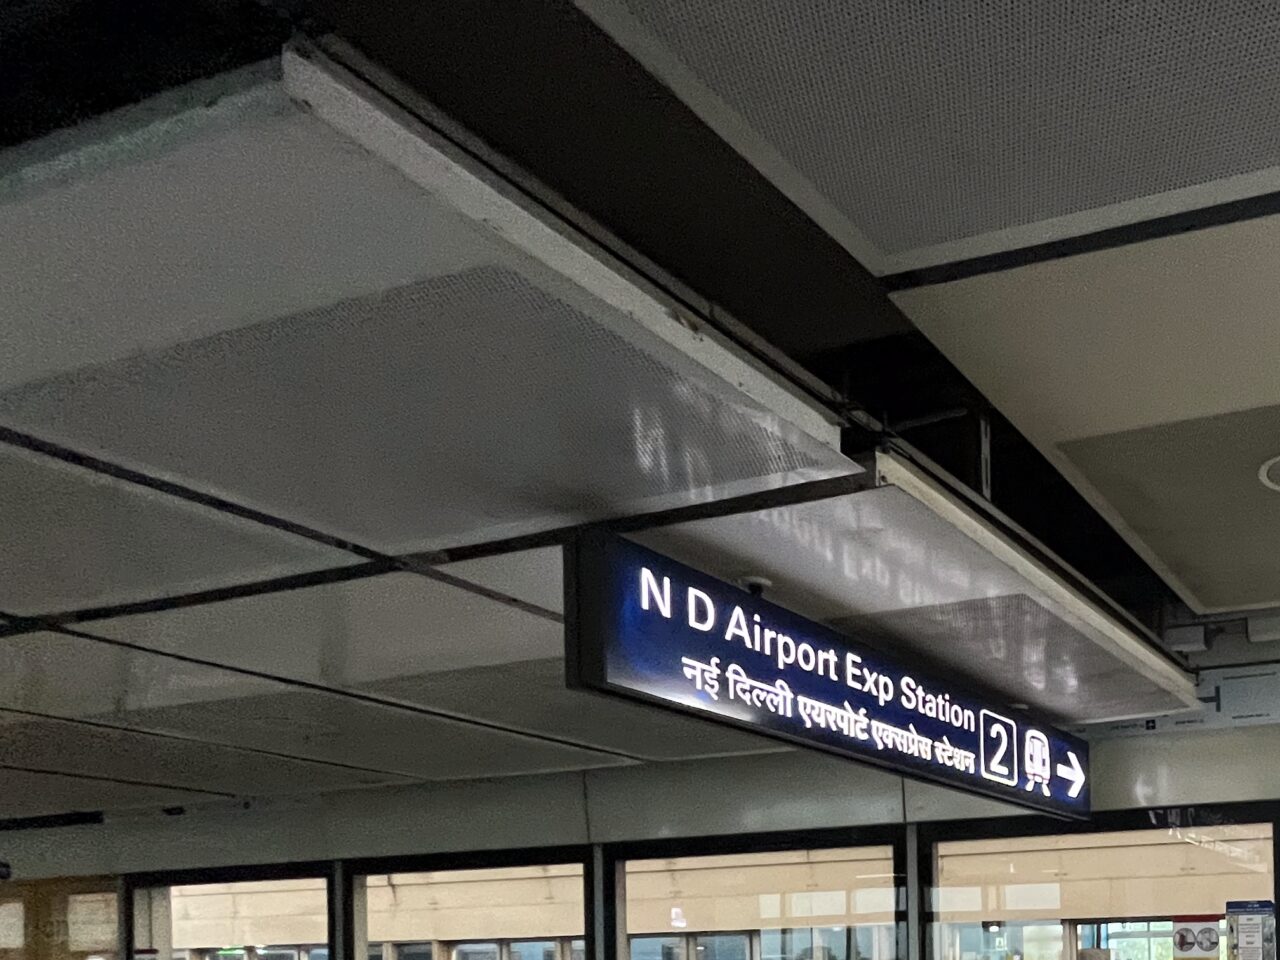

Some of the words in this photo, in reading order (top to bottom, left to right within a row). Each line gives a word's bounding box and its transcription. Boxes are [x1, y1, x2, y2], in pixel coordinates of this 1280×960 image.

[641, 567, 671, 619] N
[688, 586, 715, 632] D
[724, 605, 839, 682] Airport
[846, 651, 894, 707] Exp
[900, 675, 976, 733] Station
[681, 656, 721, 700] नई
[725, 663, 794, 718] दिल्ली
[797, 695, 869, 741] एयरपोर्ट
[871, 718, 933, 761] एक्सप्रेस
[934, 736, 976, 774] स्टेशन
[990, 723, 1009, 776] 2
